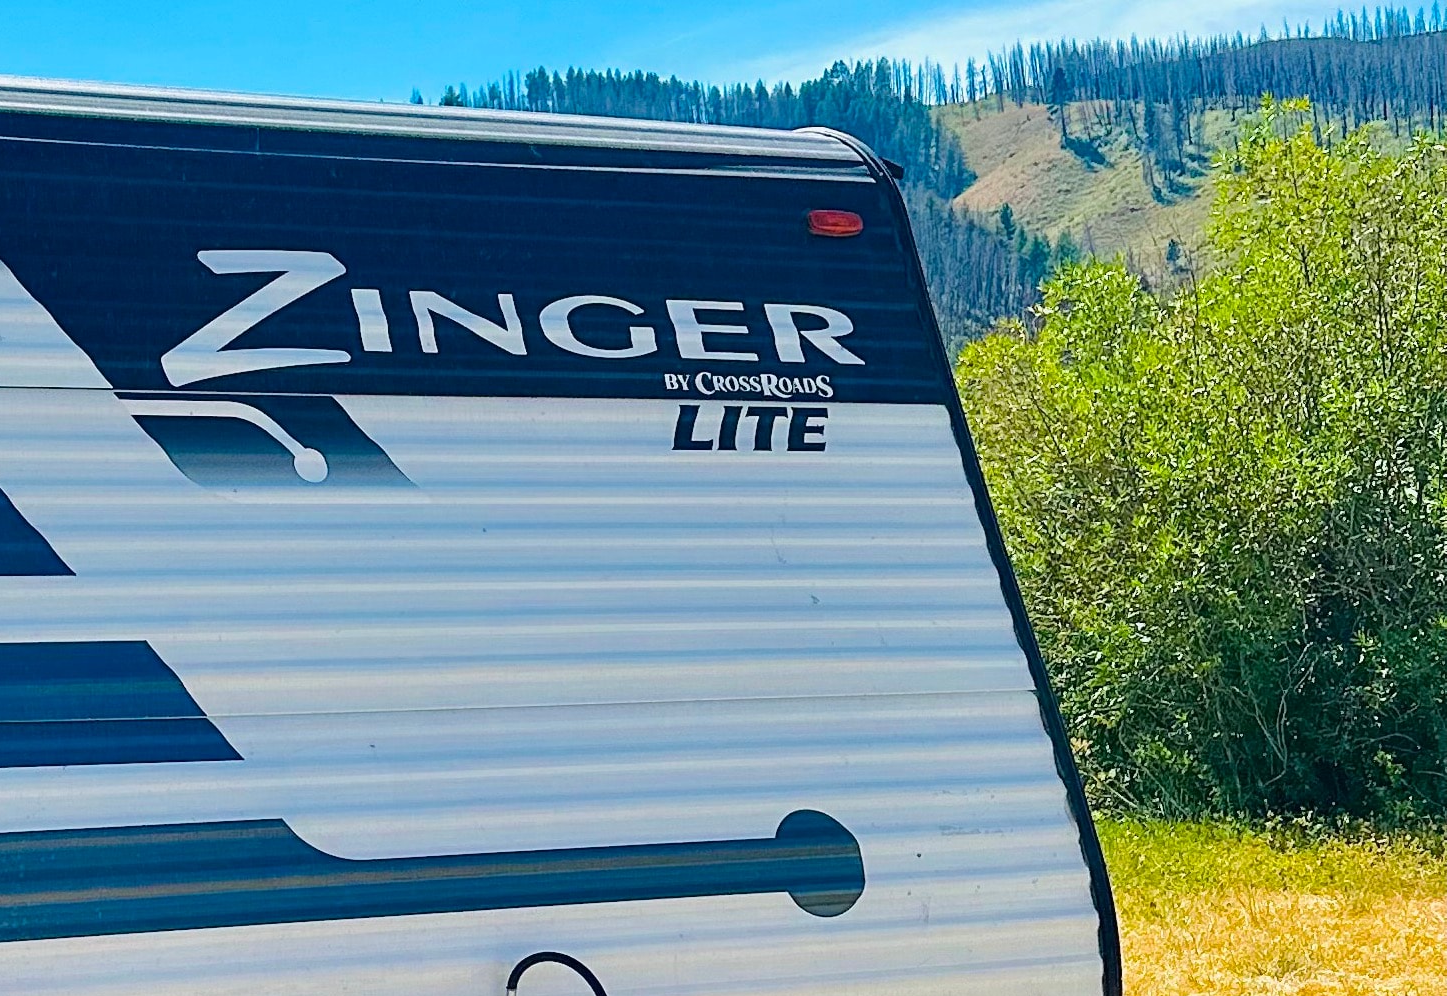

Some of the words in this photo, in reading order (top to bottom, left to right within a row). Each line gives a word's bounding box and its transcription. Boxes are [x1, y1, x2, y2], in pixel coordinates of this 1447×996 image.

[161, 249, 866, 387] ZINGER
[664, 373, 690, 391] BY
[671, 404, 829, 452] LITE
